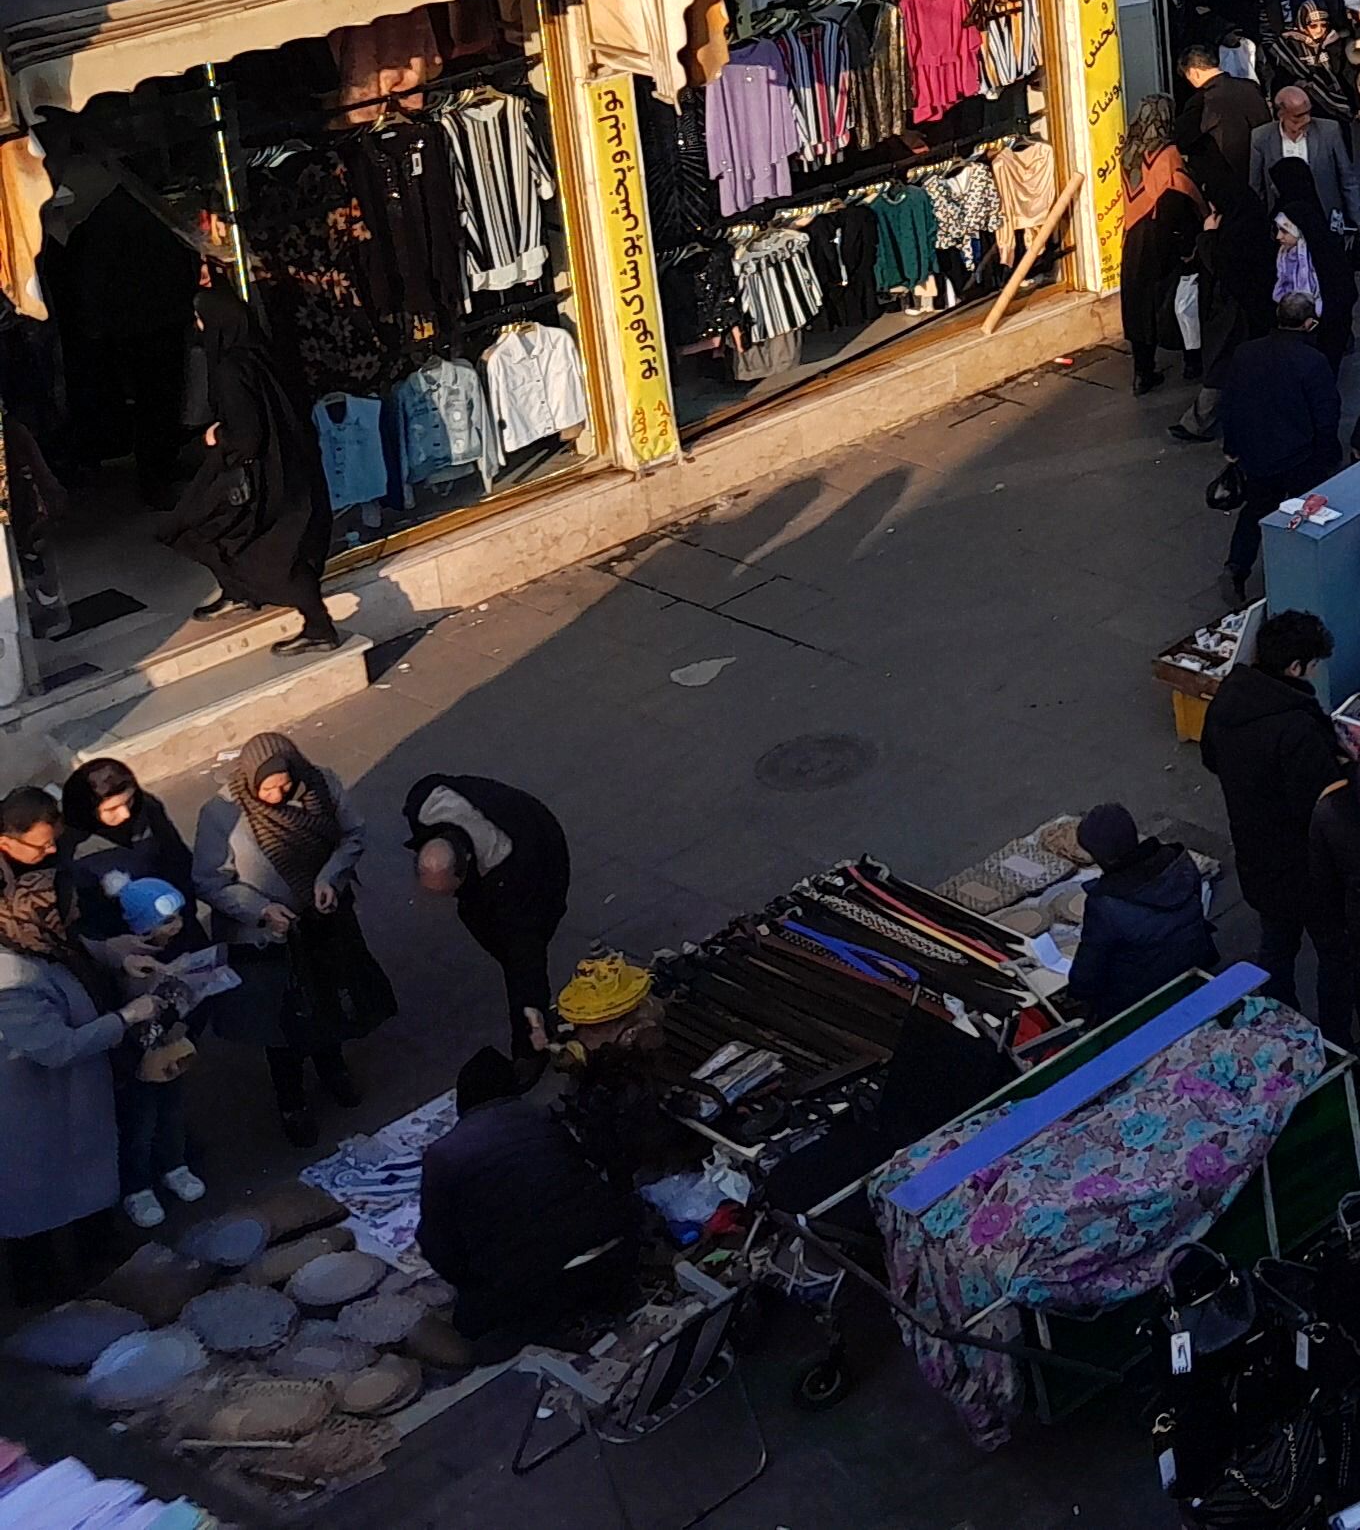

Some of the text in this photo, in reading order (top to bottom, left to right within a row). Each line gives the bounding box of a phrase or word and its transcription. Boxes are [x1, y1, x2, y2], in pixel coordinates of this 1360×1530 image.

[1101, 1, 1109, 14] و
[597, 89, 659, 381] تولید و پخش پوشاک فوریو
[631, 405, 649, 445] عمده
[653, 399, 671, 437] خرده
